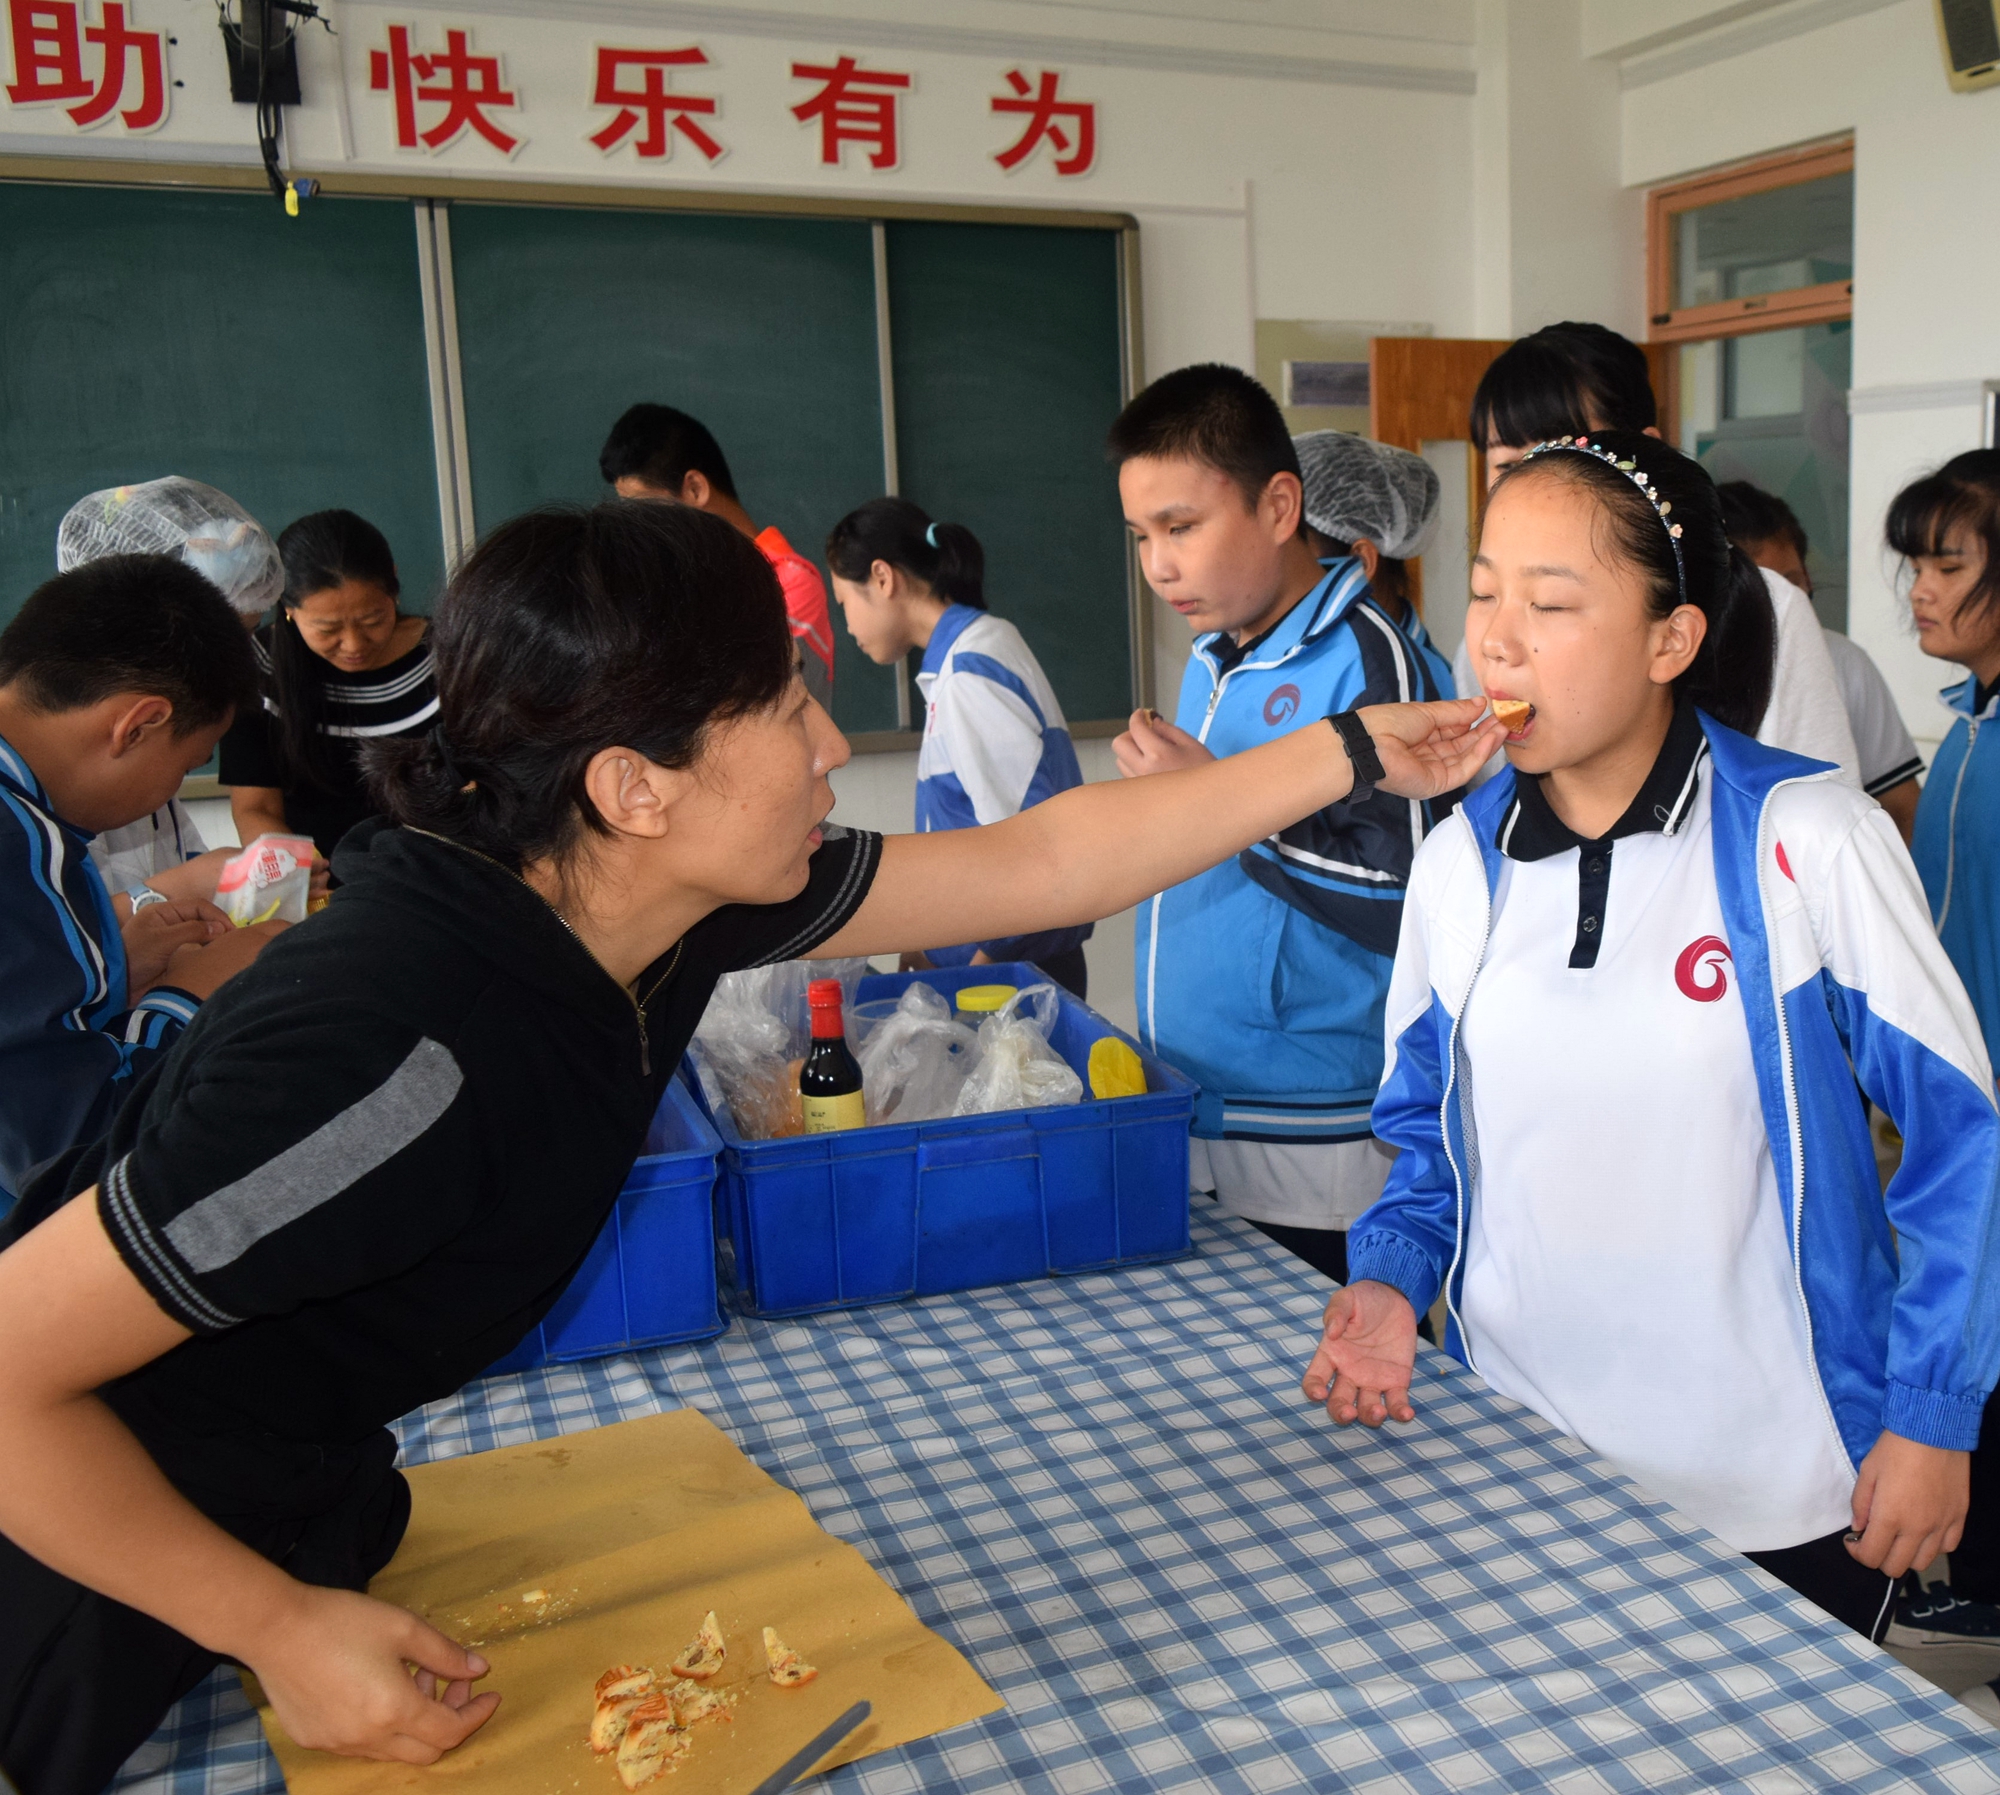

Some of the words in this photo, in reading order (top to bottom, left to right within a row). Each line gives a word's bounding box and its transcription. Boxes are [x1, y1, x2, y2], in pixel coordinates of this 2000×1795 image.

[6, 0, 164, 130] 助
[370, 25, 1096, 176] 快乐有为
